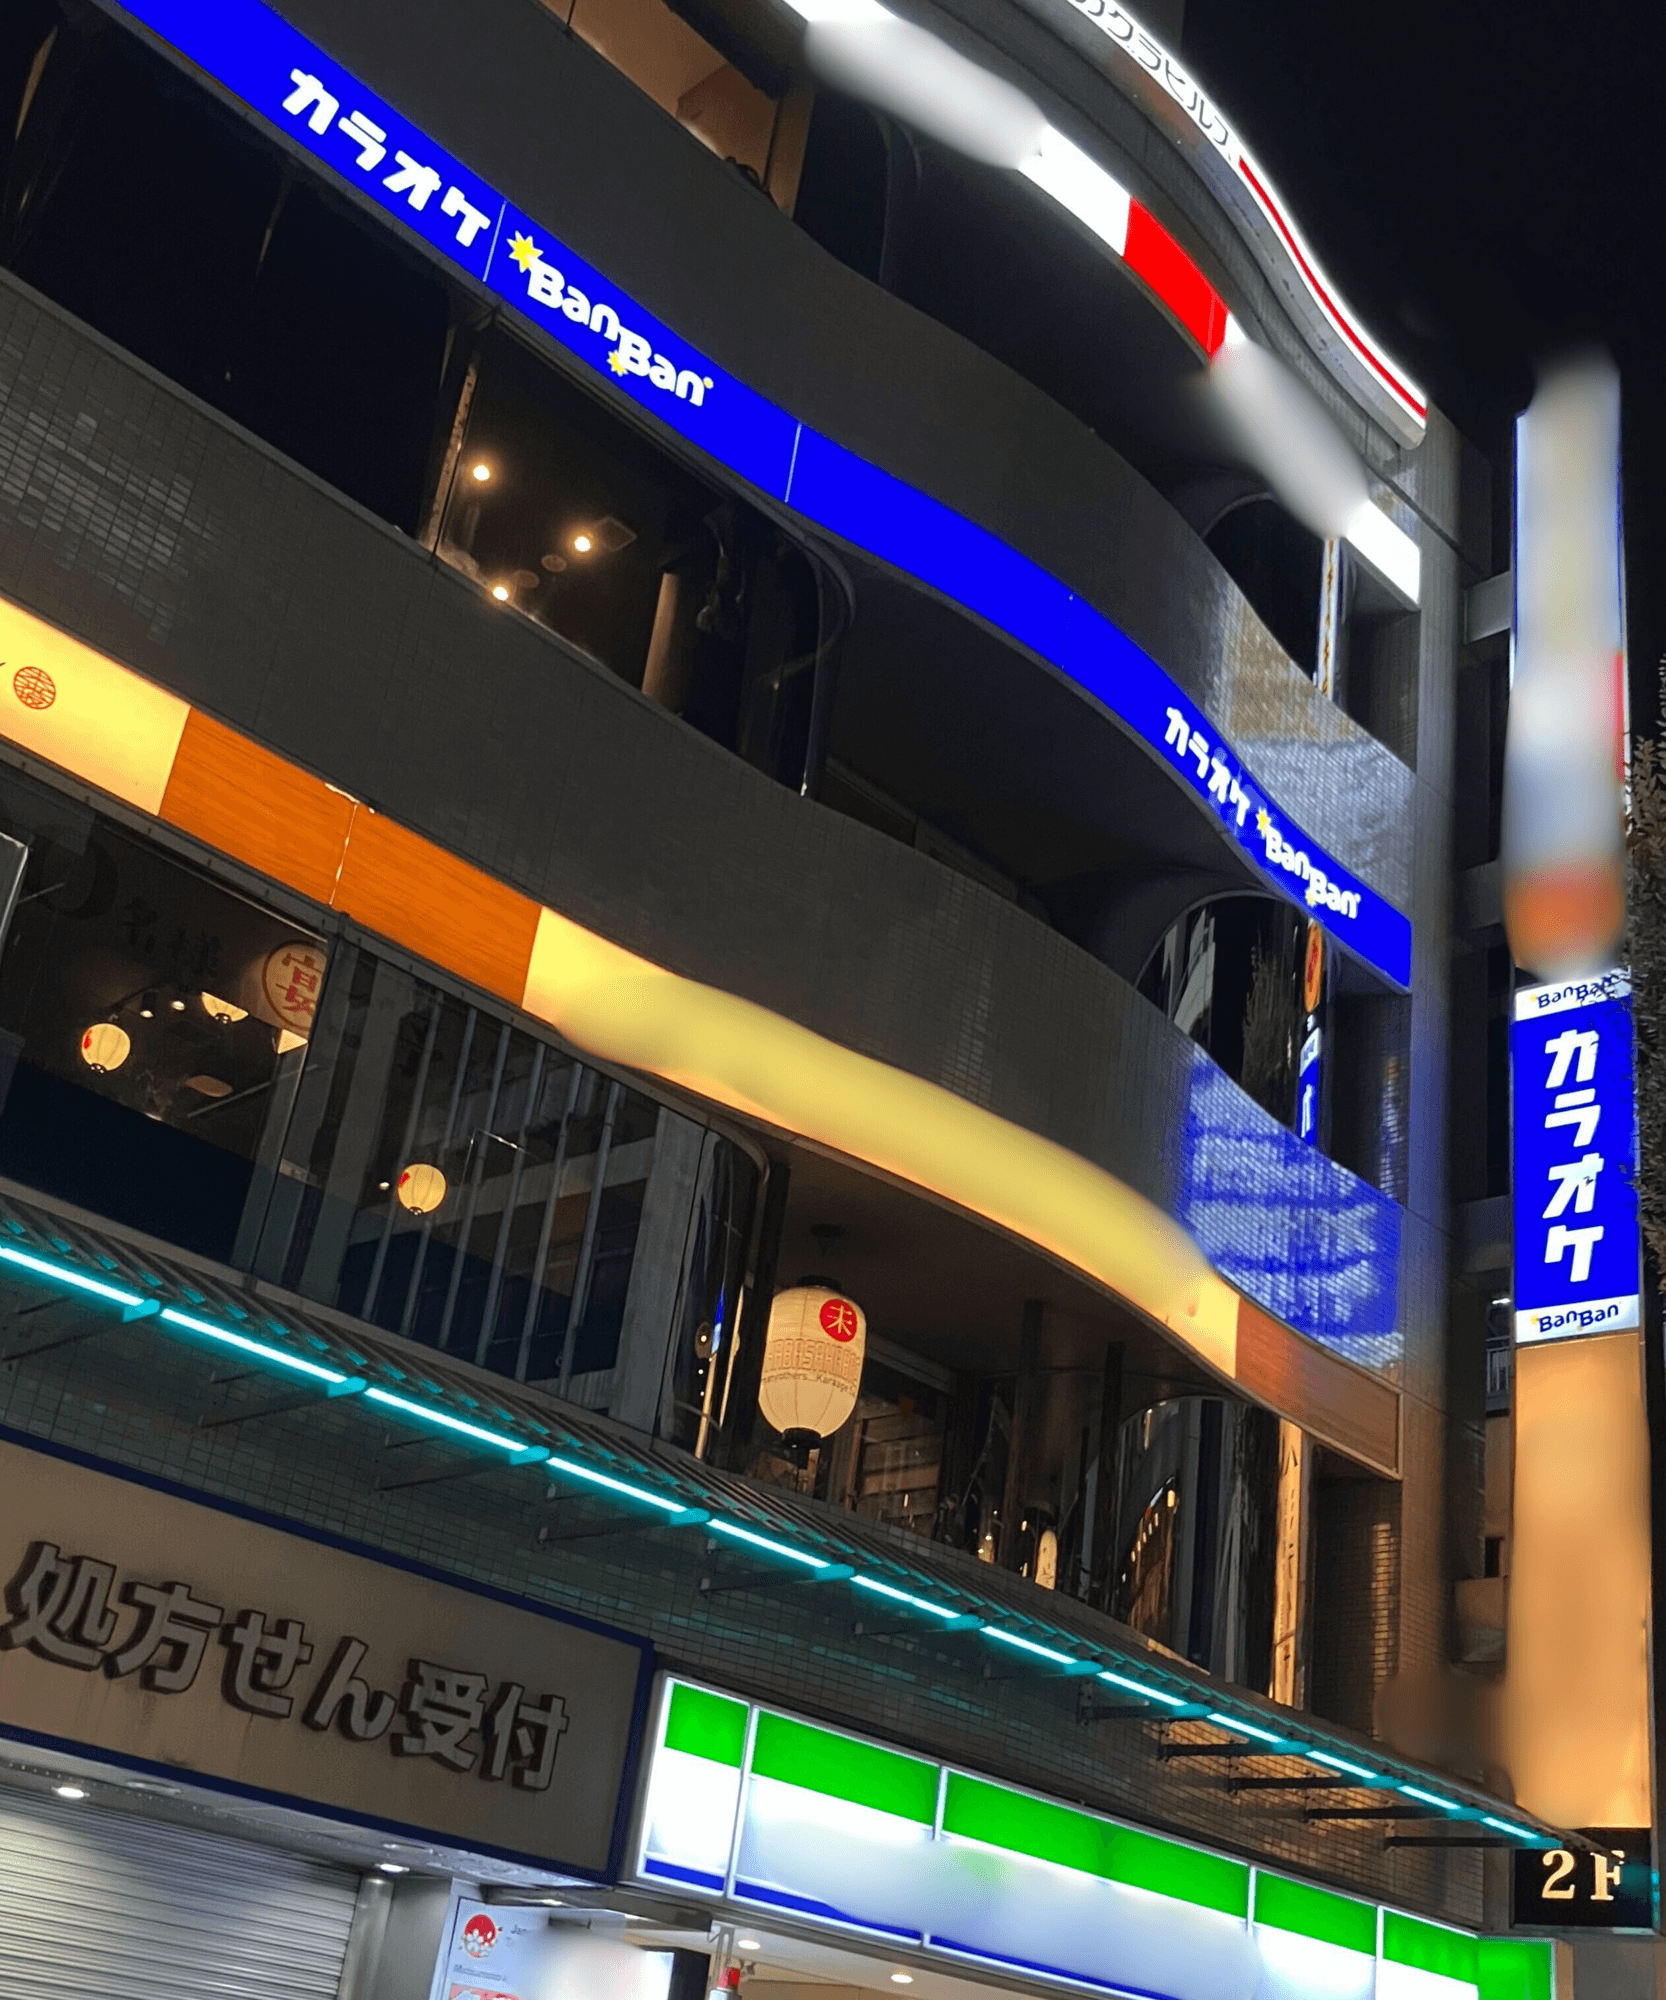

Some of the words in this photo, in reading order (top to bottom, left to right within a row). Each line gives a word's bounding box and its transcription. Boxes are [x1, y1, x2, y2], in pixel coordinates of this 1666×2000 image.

[282, 68, 491, 247] カラオケ
[526, 254, 706, 407] BanBan
[1165, 706, 1250, 827] カラオケ
[1265, 824, 1359, 919] BanBan
[1542, 1028, 1605, 1283] カラオケ
[1538, 1304, 1620, 1334] BanBan
[0, 1540, 570, 1792] 処方せん受付
